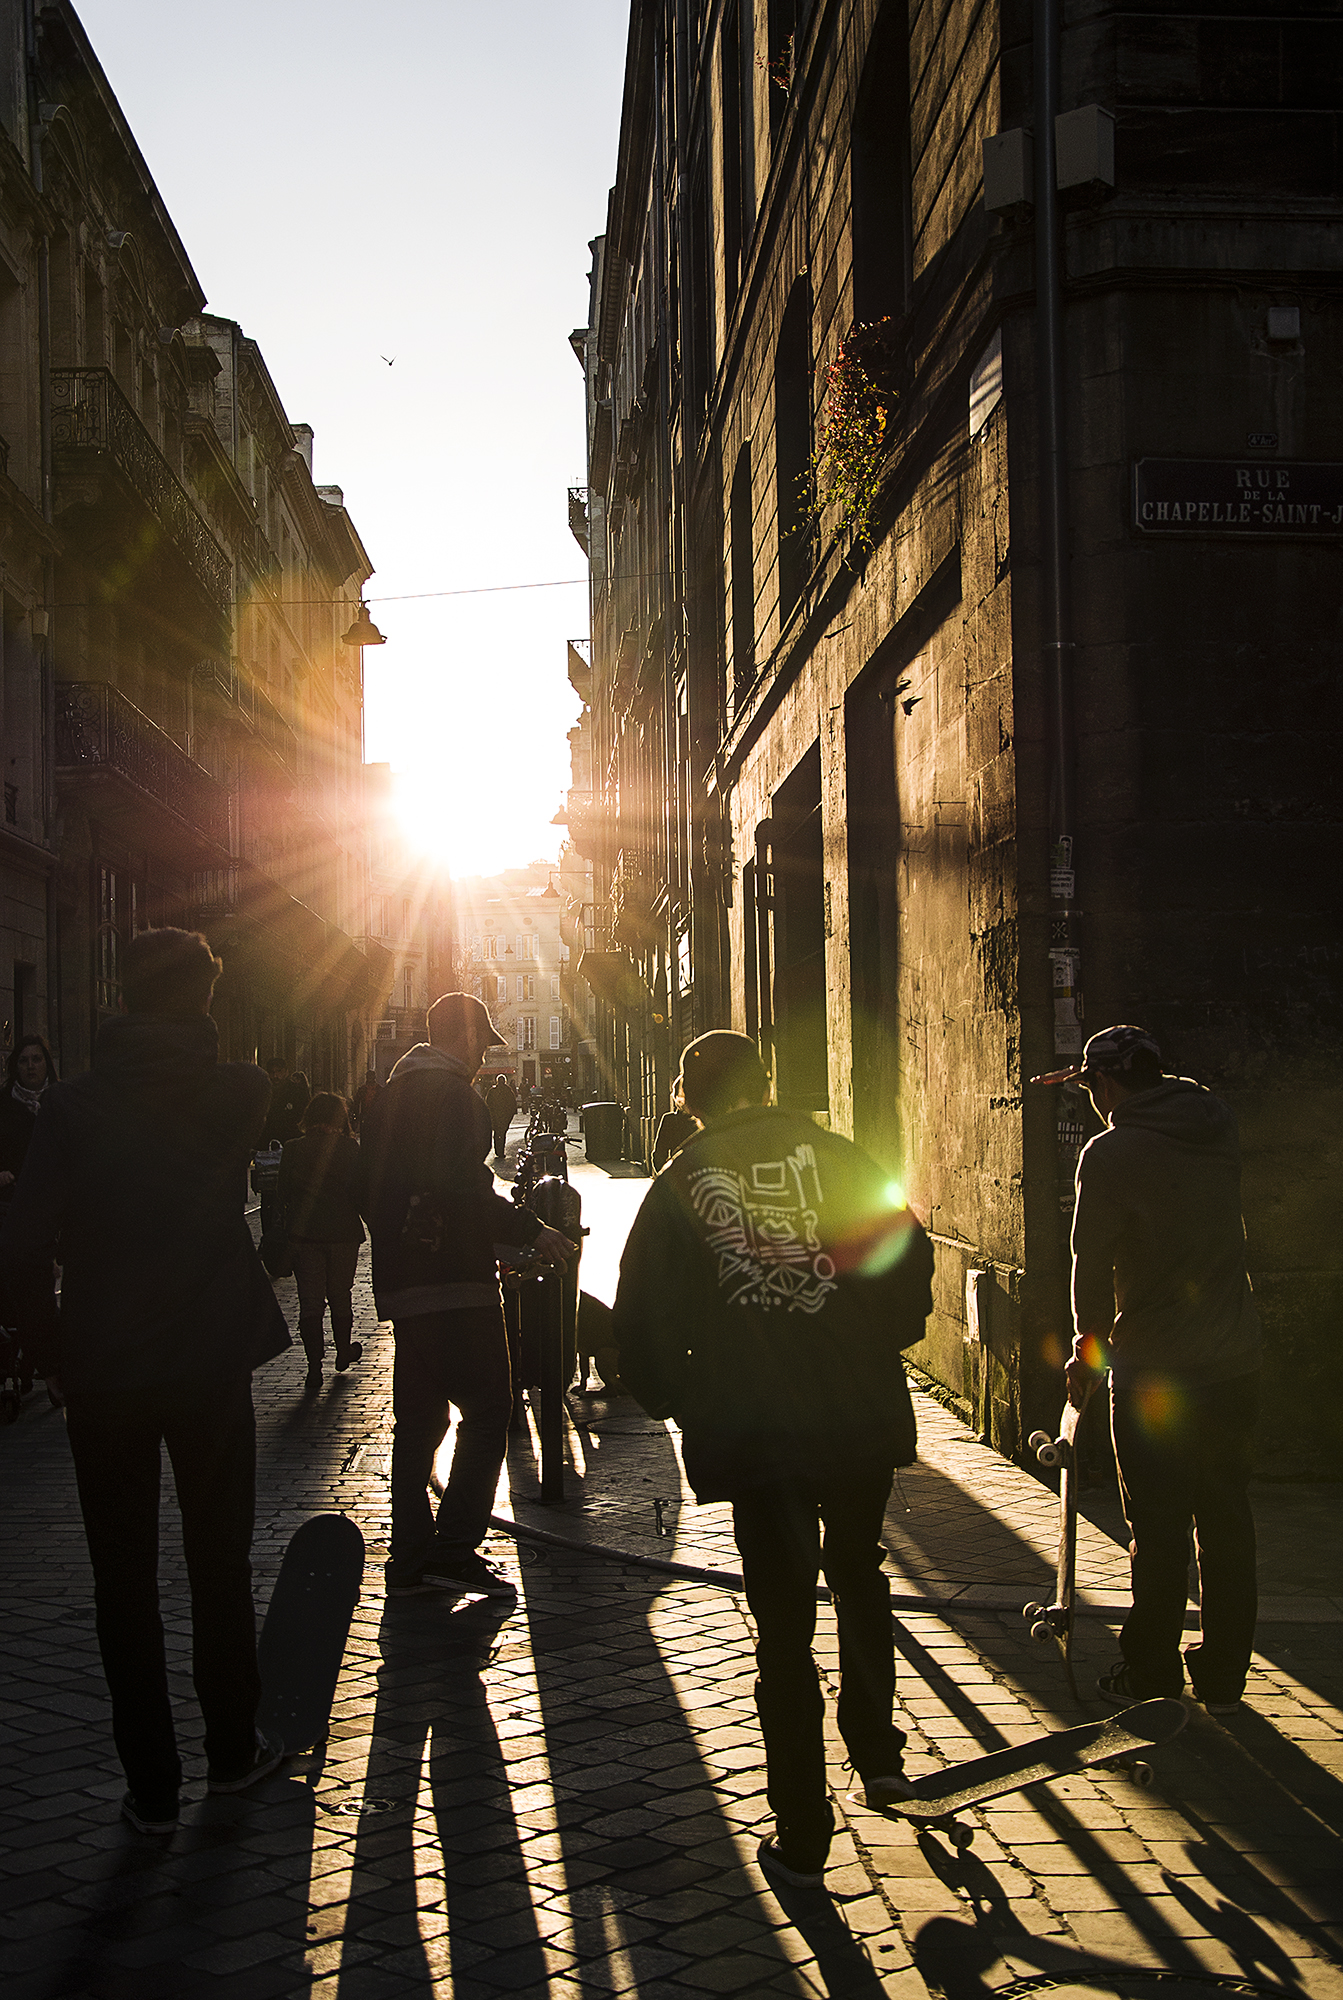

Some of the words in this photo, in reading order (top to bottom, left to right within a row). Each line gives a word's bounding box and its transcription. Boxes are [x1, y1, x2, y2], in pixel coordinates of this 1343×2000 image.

[1235, 469, 1290, 488] RUE
[1243, 490, 1261, 500] DE
[1267, 491, 1286, 501] LA
[1142, 501, 1343, 525] CHAPELLE-SAINT-J
